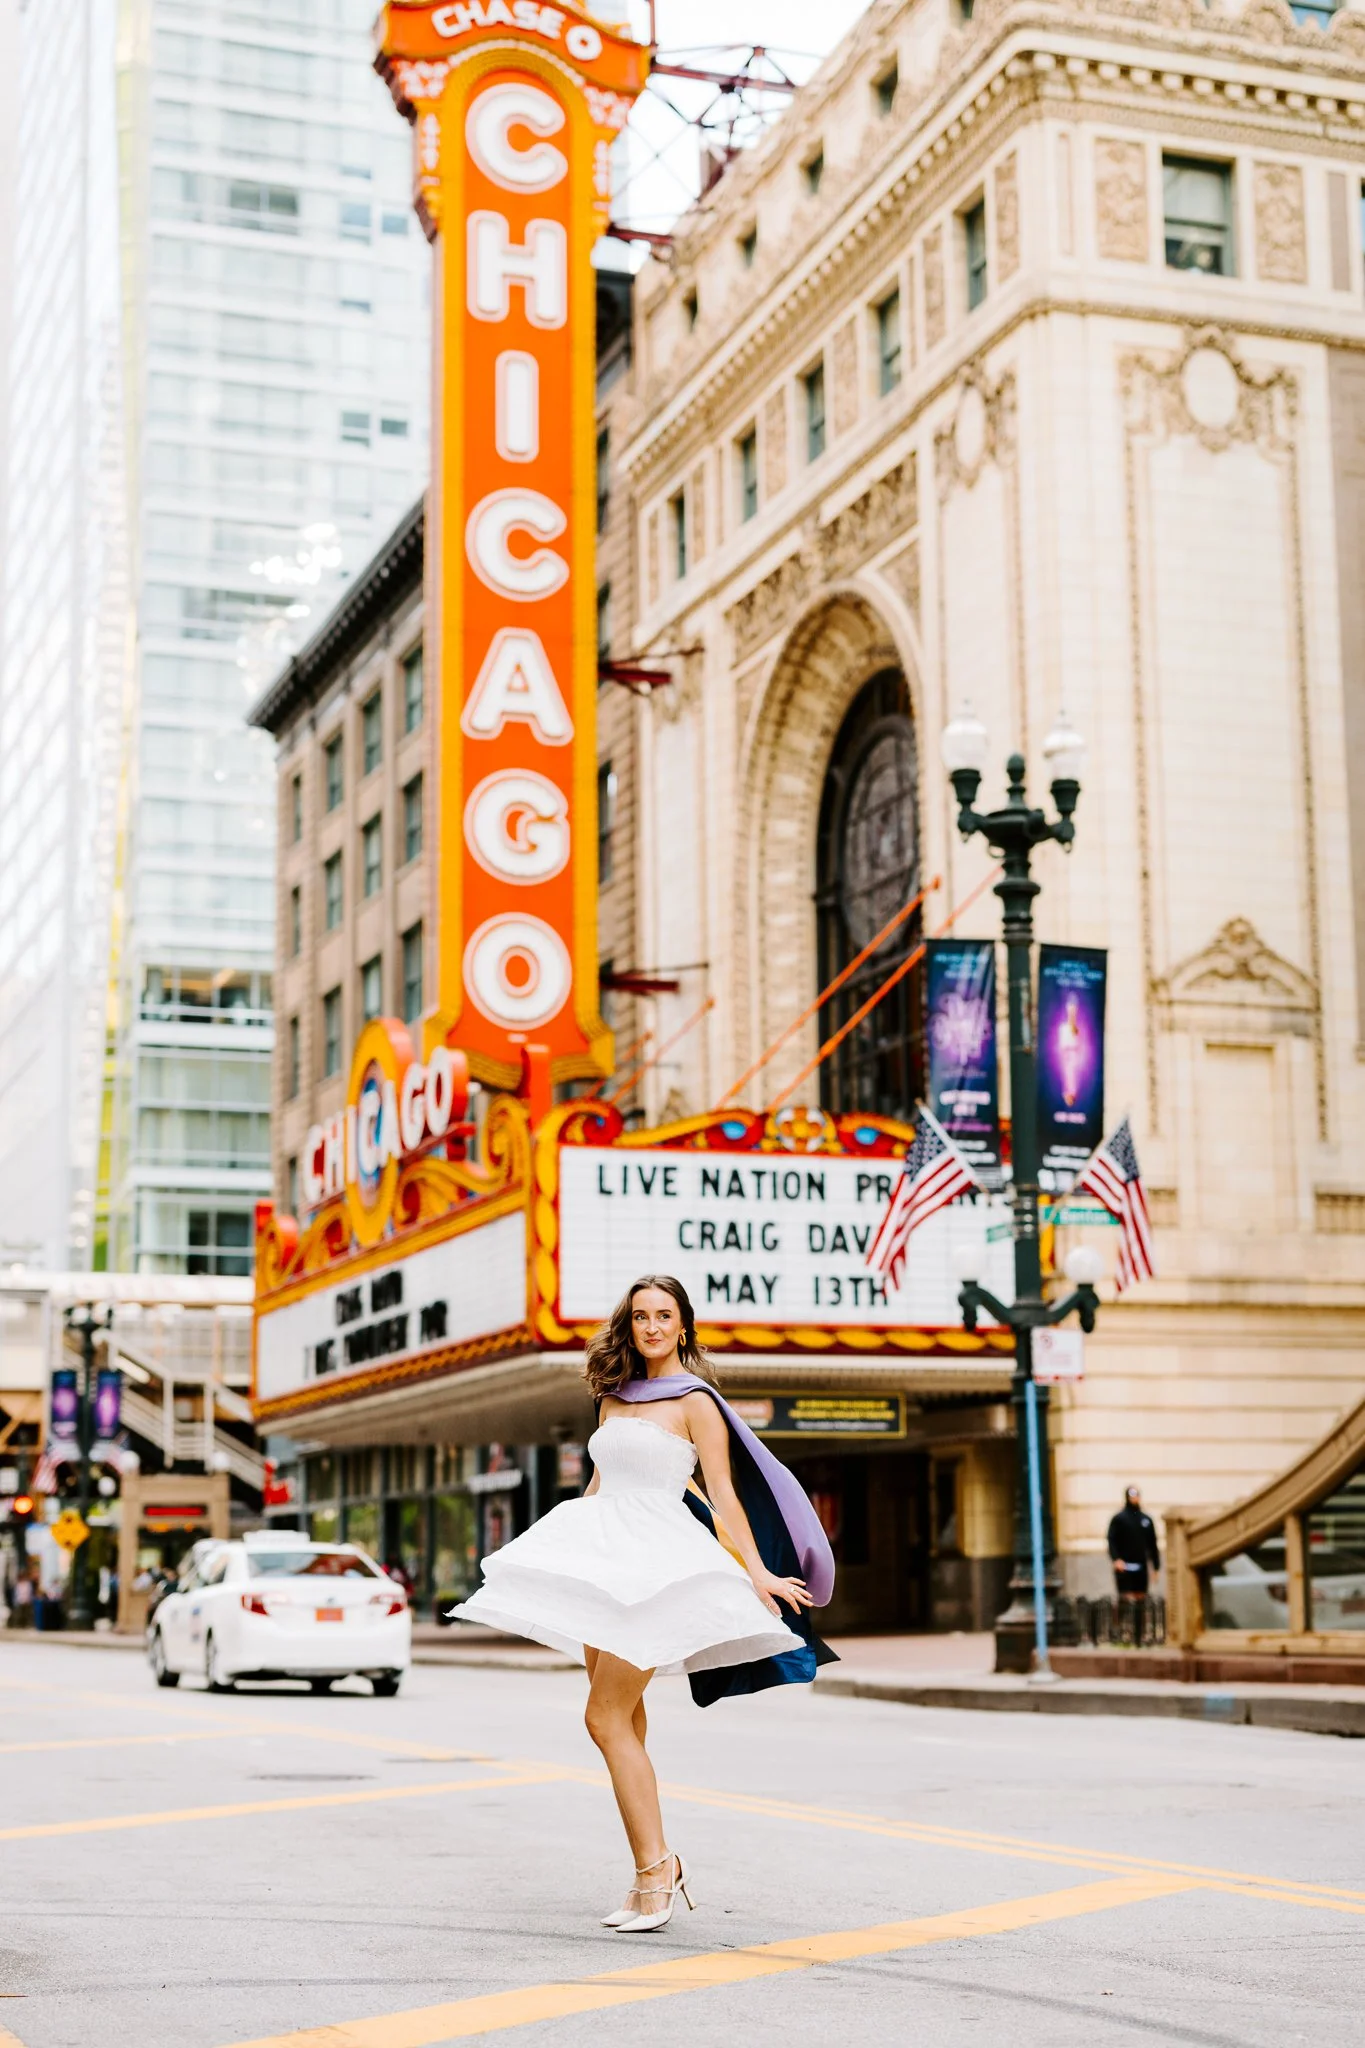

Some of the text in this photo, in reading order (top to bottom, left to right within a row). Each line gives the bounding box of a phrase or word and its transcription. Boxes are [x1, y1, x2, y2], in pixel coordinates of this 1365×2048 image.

[432, 0, 566, 39] CHASE
[461, 81, 575, 1031] CHICAGO
[303, 1045, 454, 1202] CHICAGO
[598, 1163, 678, 1196] LIVE
[701, 1167, 826, 1201] NATION
[678, 1219, 871, 1255] CRAIG DAV
[707, 1273, 889, 1306] MAY 13TH
